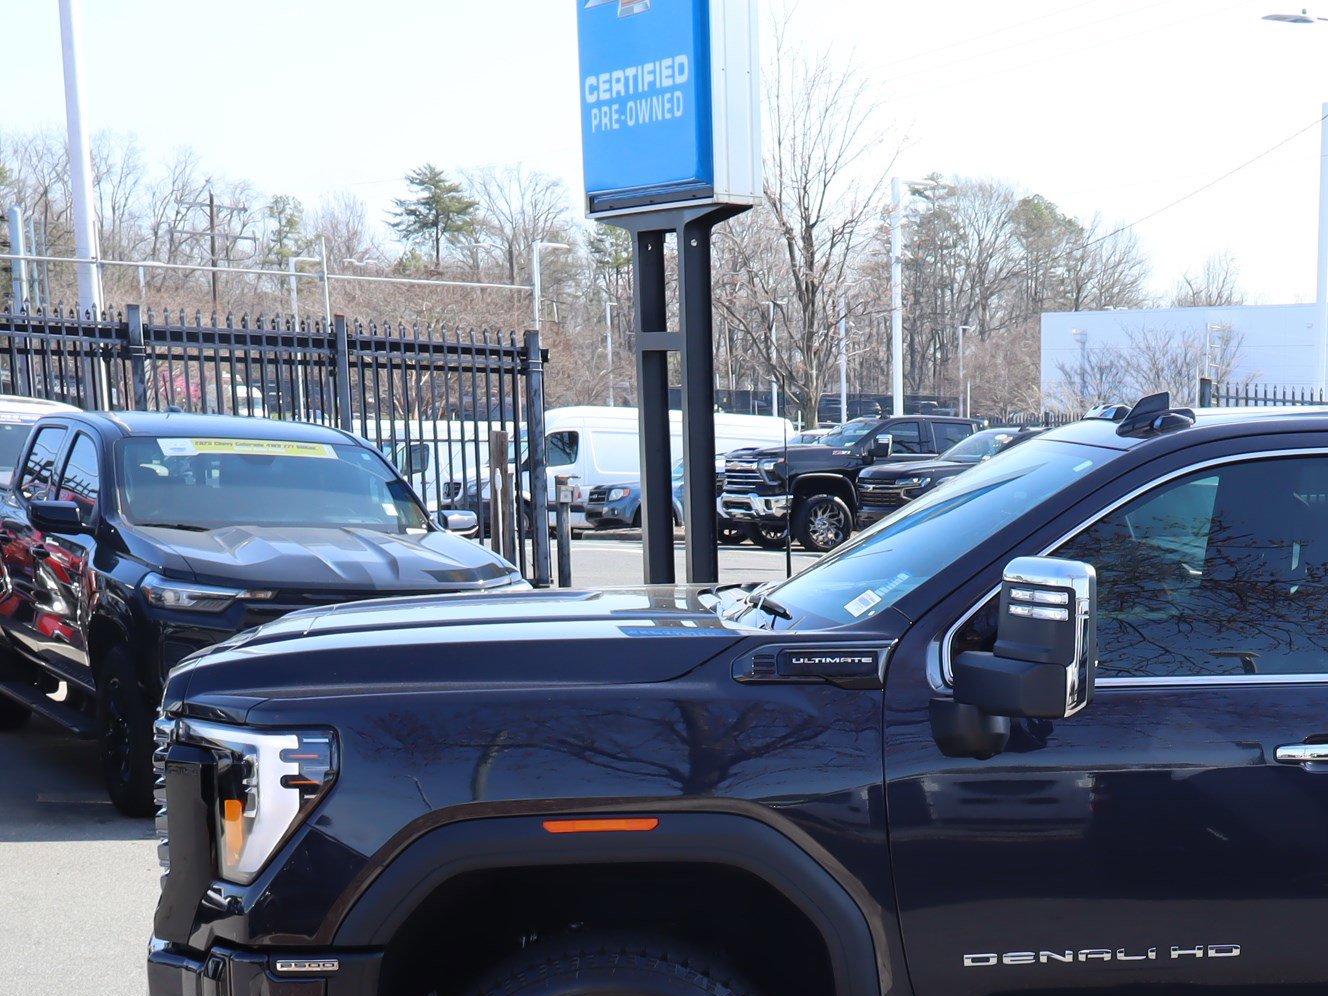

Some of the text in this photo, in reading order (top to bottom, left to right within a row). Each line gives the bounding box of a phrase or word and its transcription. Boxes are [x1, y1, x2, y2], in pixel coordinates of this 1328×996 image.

[585, 54, 689, 103] CERTIFIED
[591, 90, 684, 133] PRE-OWNED
[963, 944, 1241, 967] DENALI HD
